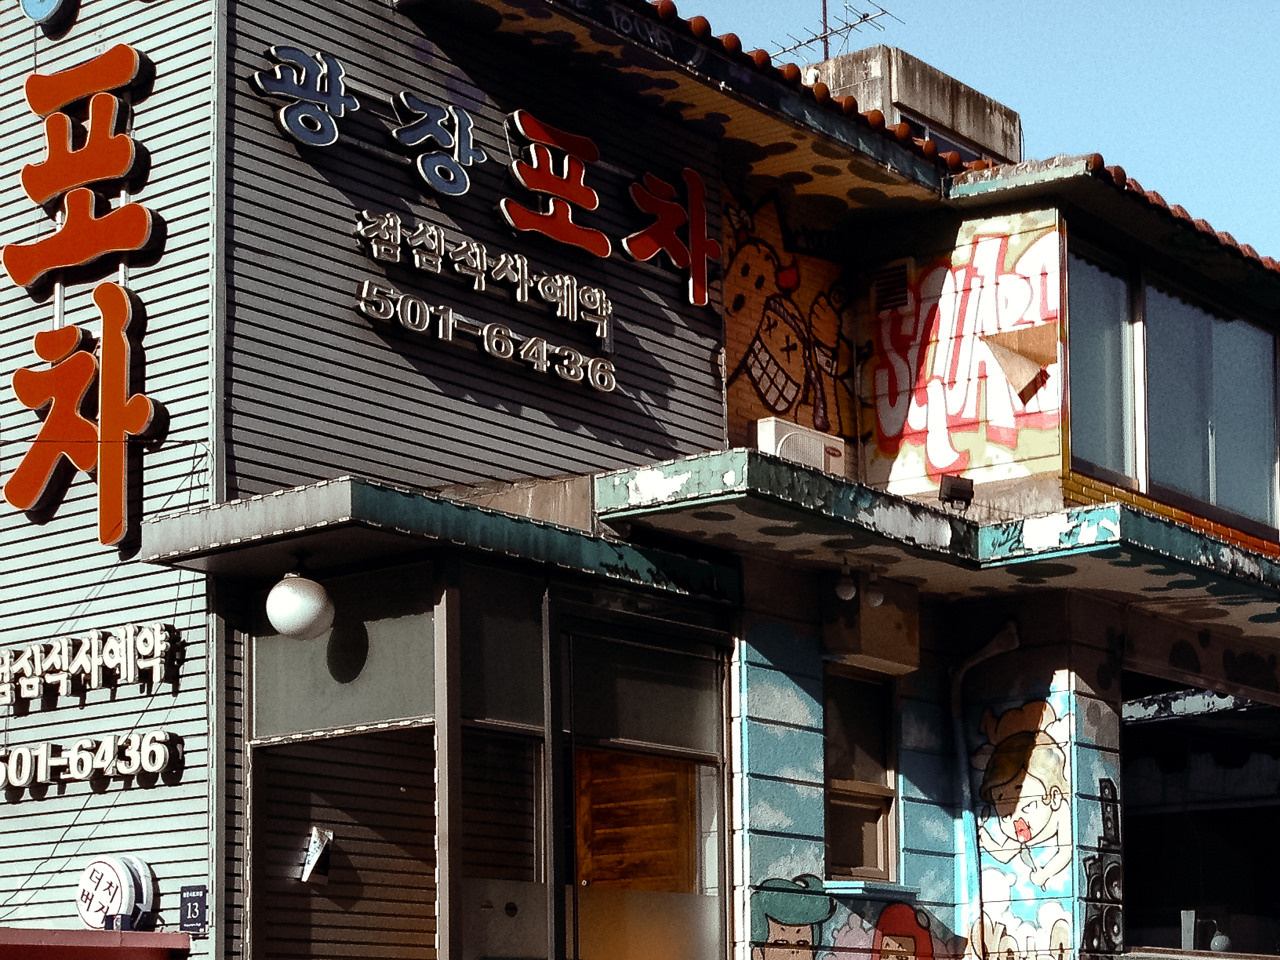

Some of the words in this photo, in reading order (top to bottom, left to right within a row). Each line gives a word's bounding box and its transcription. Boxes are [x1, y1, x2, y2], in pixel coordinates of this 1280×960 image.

[3, 43, 156, 546] 포차
[356, 279, 616, 392] 501-6436
[89, 868, 119, 904] 더치
[186, 902, 200, 919] 13
